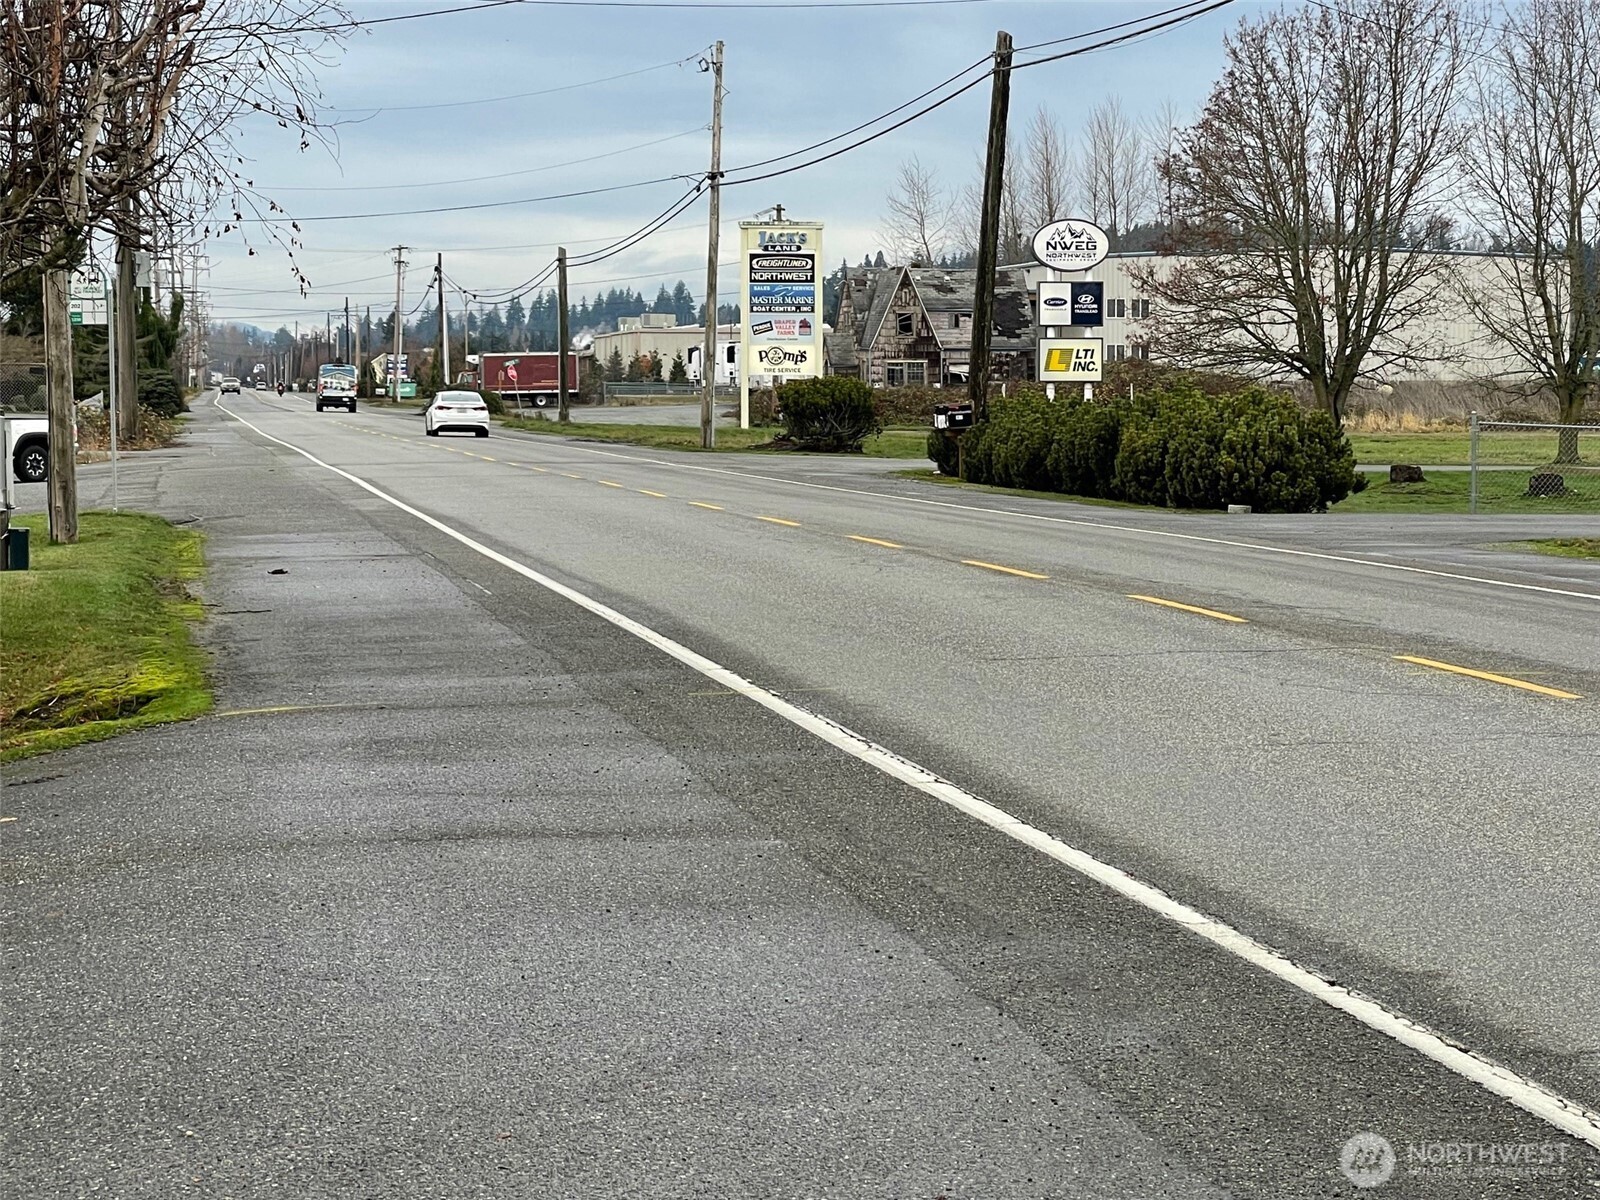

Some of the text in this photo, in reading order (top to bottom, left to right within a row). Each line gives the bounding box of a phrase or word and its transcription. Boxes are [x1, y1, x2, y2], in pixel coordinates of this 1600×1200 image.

[1046, 241, 1097, 251] NWEG
[751, 272, 813, 280] NORTHWEST
[751, 296, 814, 304] MASTER MARINE
[1075, 349, 1095, 359] LTI
[1073, 361, 1098, 372] INC.
